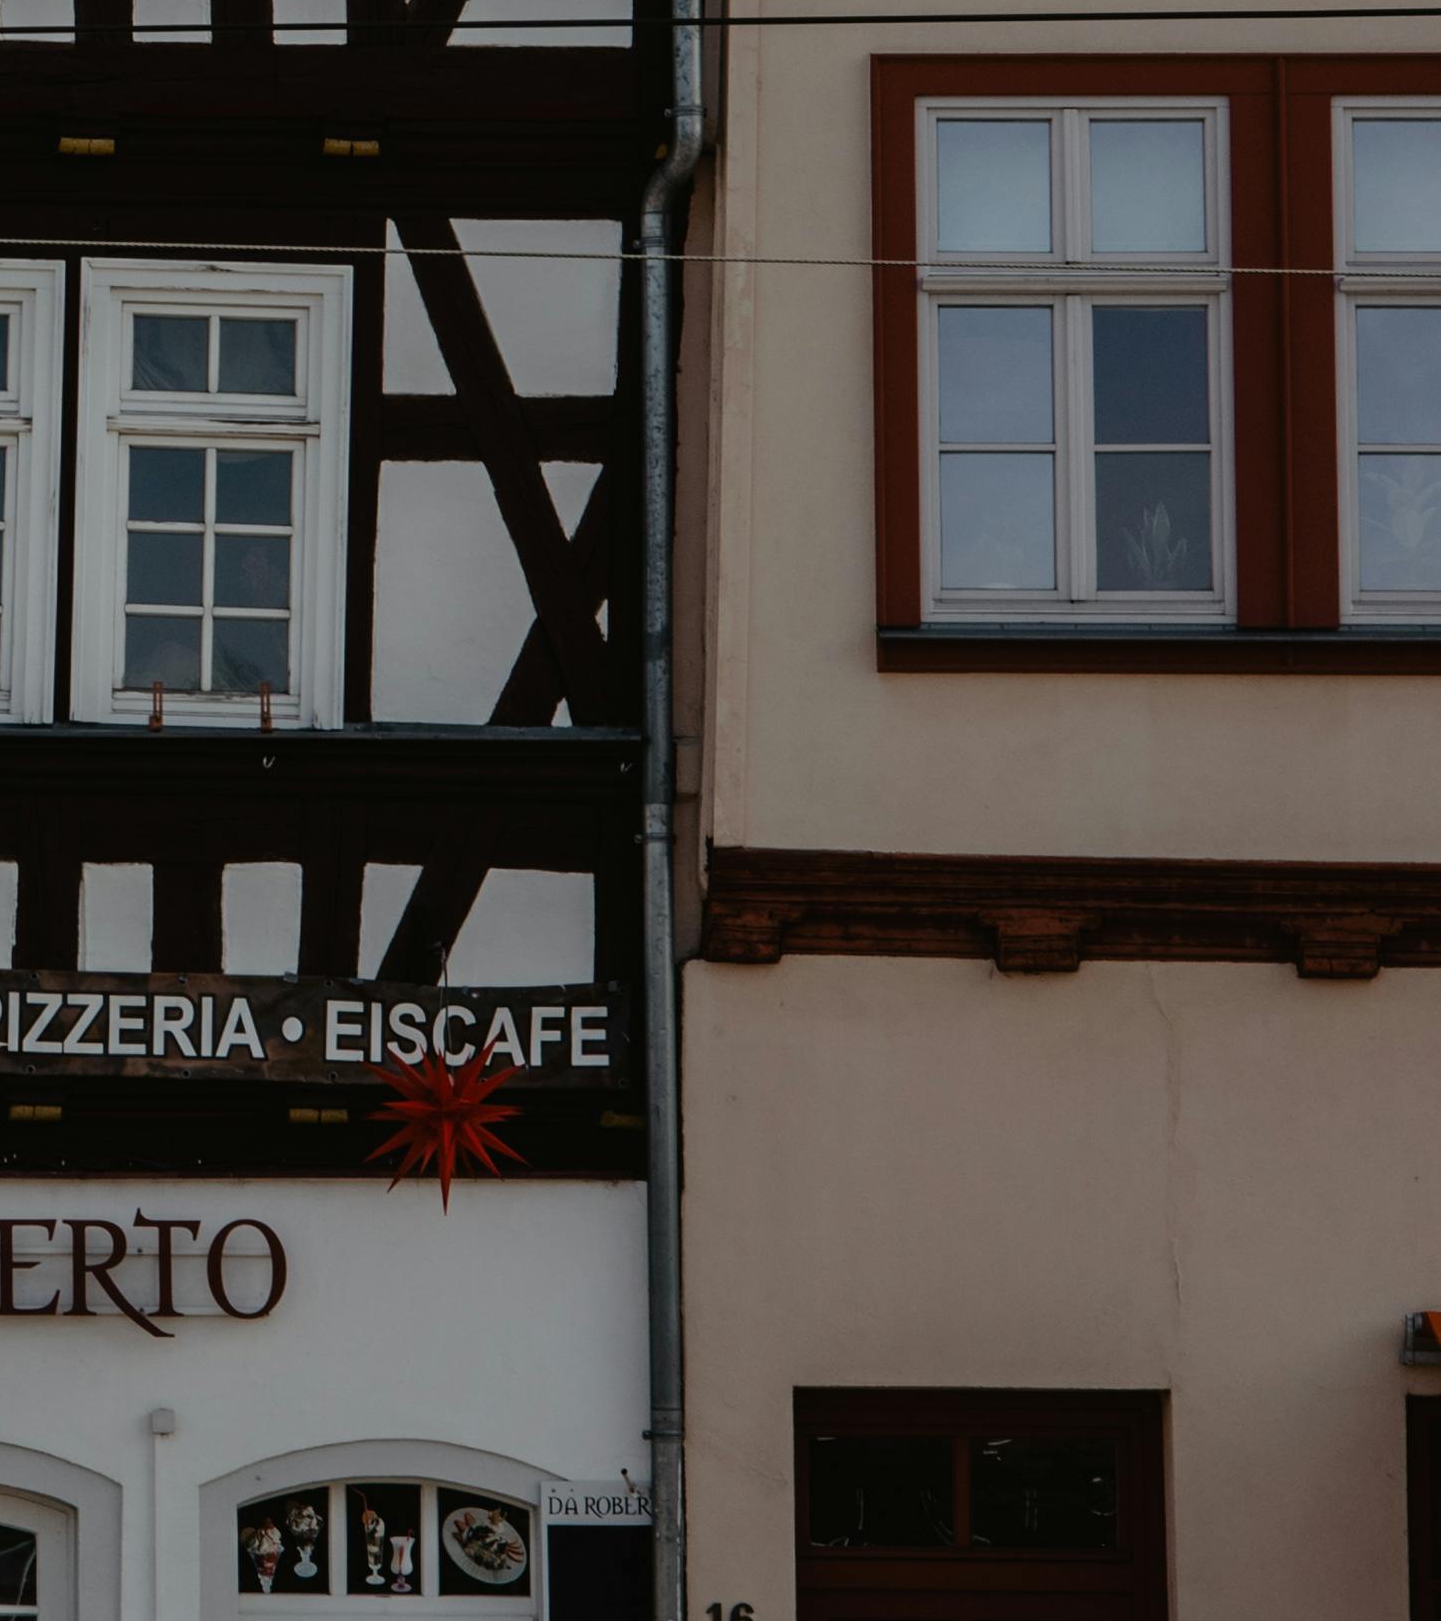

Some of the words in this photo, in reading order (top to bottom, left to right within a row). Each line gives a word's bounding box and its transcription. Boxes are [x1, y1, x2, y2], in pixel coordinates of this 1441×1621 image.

[325, 1000, 610, 1068] EISCAFE
[549, 1497, 578, 1515] DA
[585, 1497, 655, 1518] ROBER
